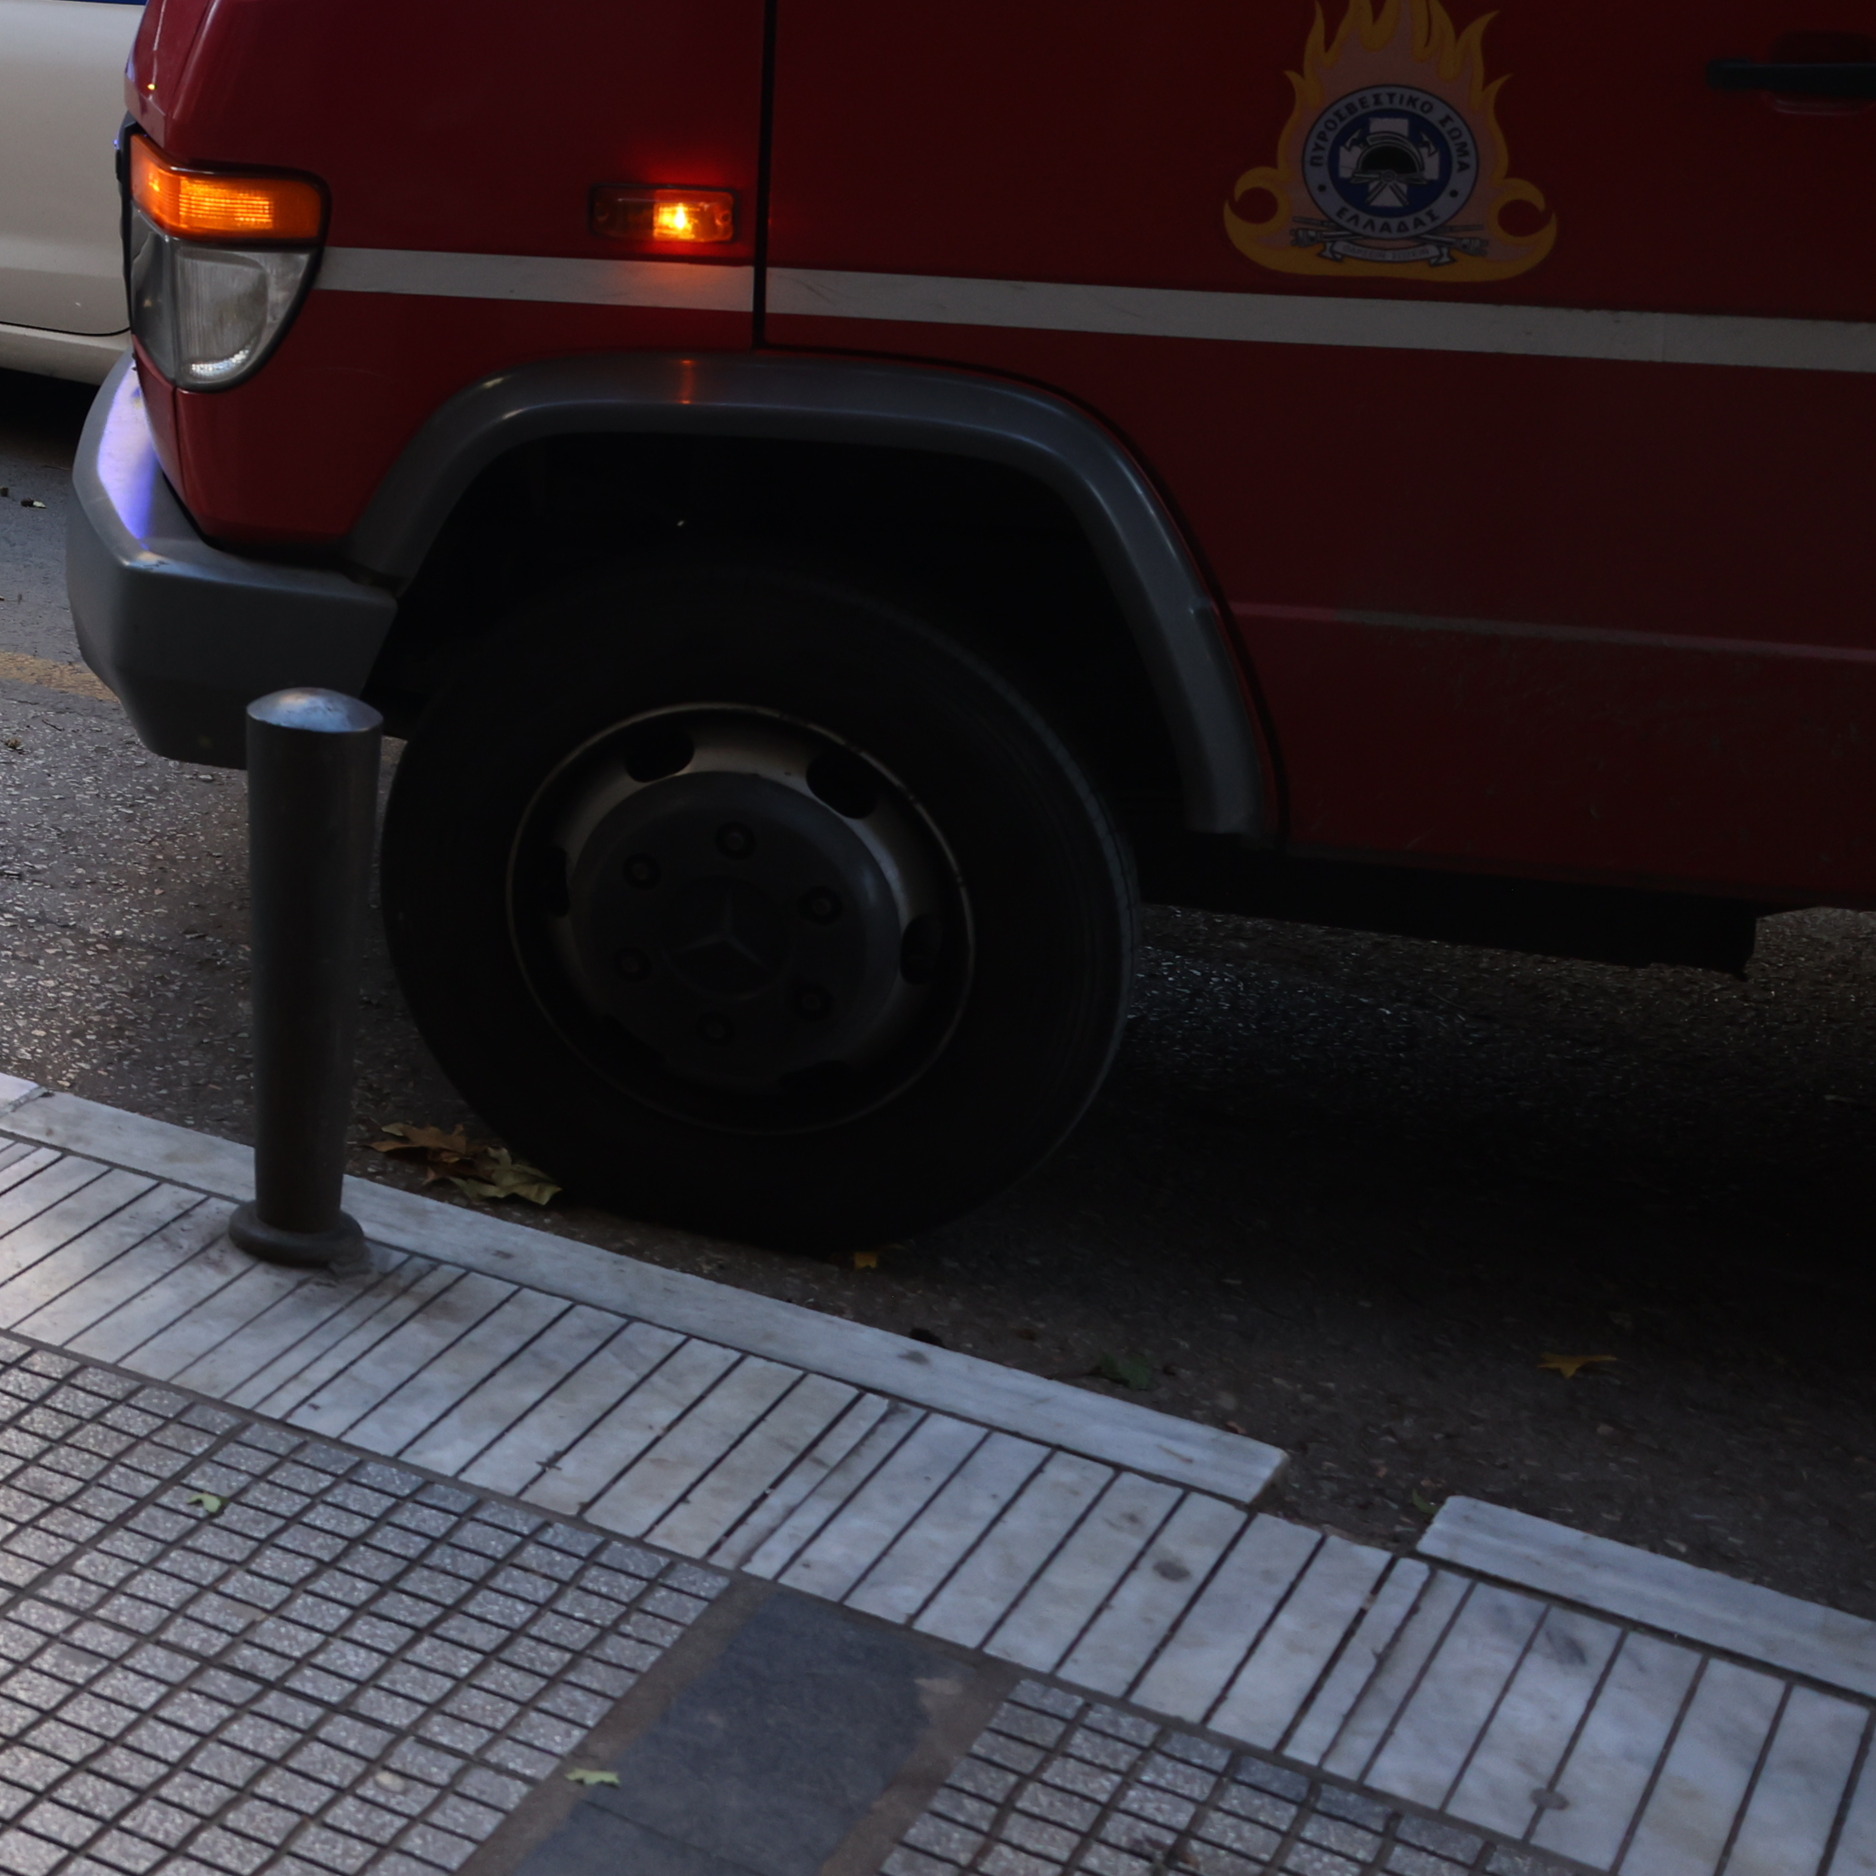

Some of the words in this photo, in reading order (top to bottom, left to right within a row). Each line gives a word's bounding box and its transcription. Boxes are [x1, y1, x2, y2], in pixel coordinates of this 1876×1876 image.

[1310, 92, 1435, 168] ΠΥΡΟΣΒΕΣΤΙΚΟ
[1438, 114, 1471, 176] ΣΩΜΑ
[1335, 206, 1441, 234] ΕΛΛΑΔΑΣ
